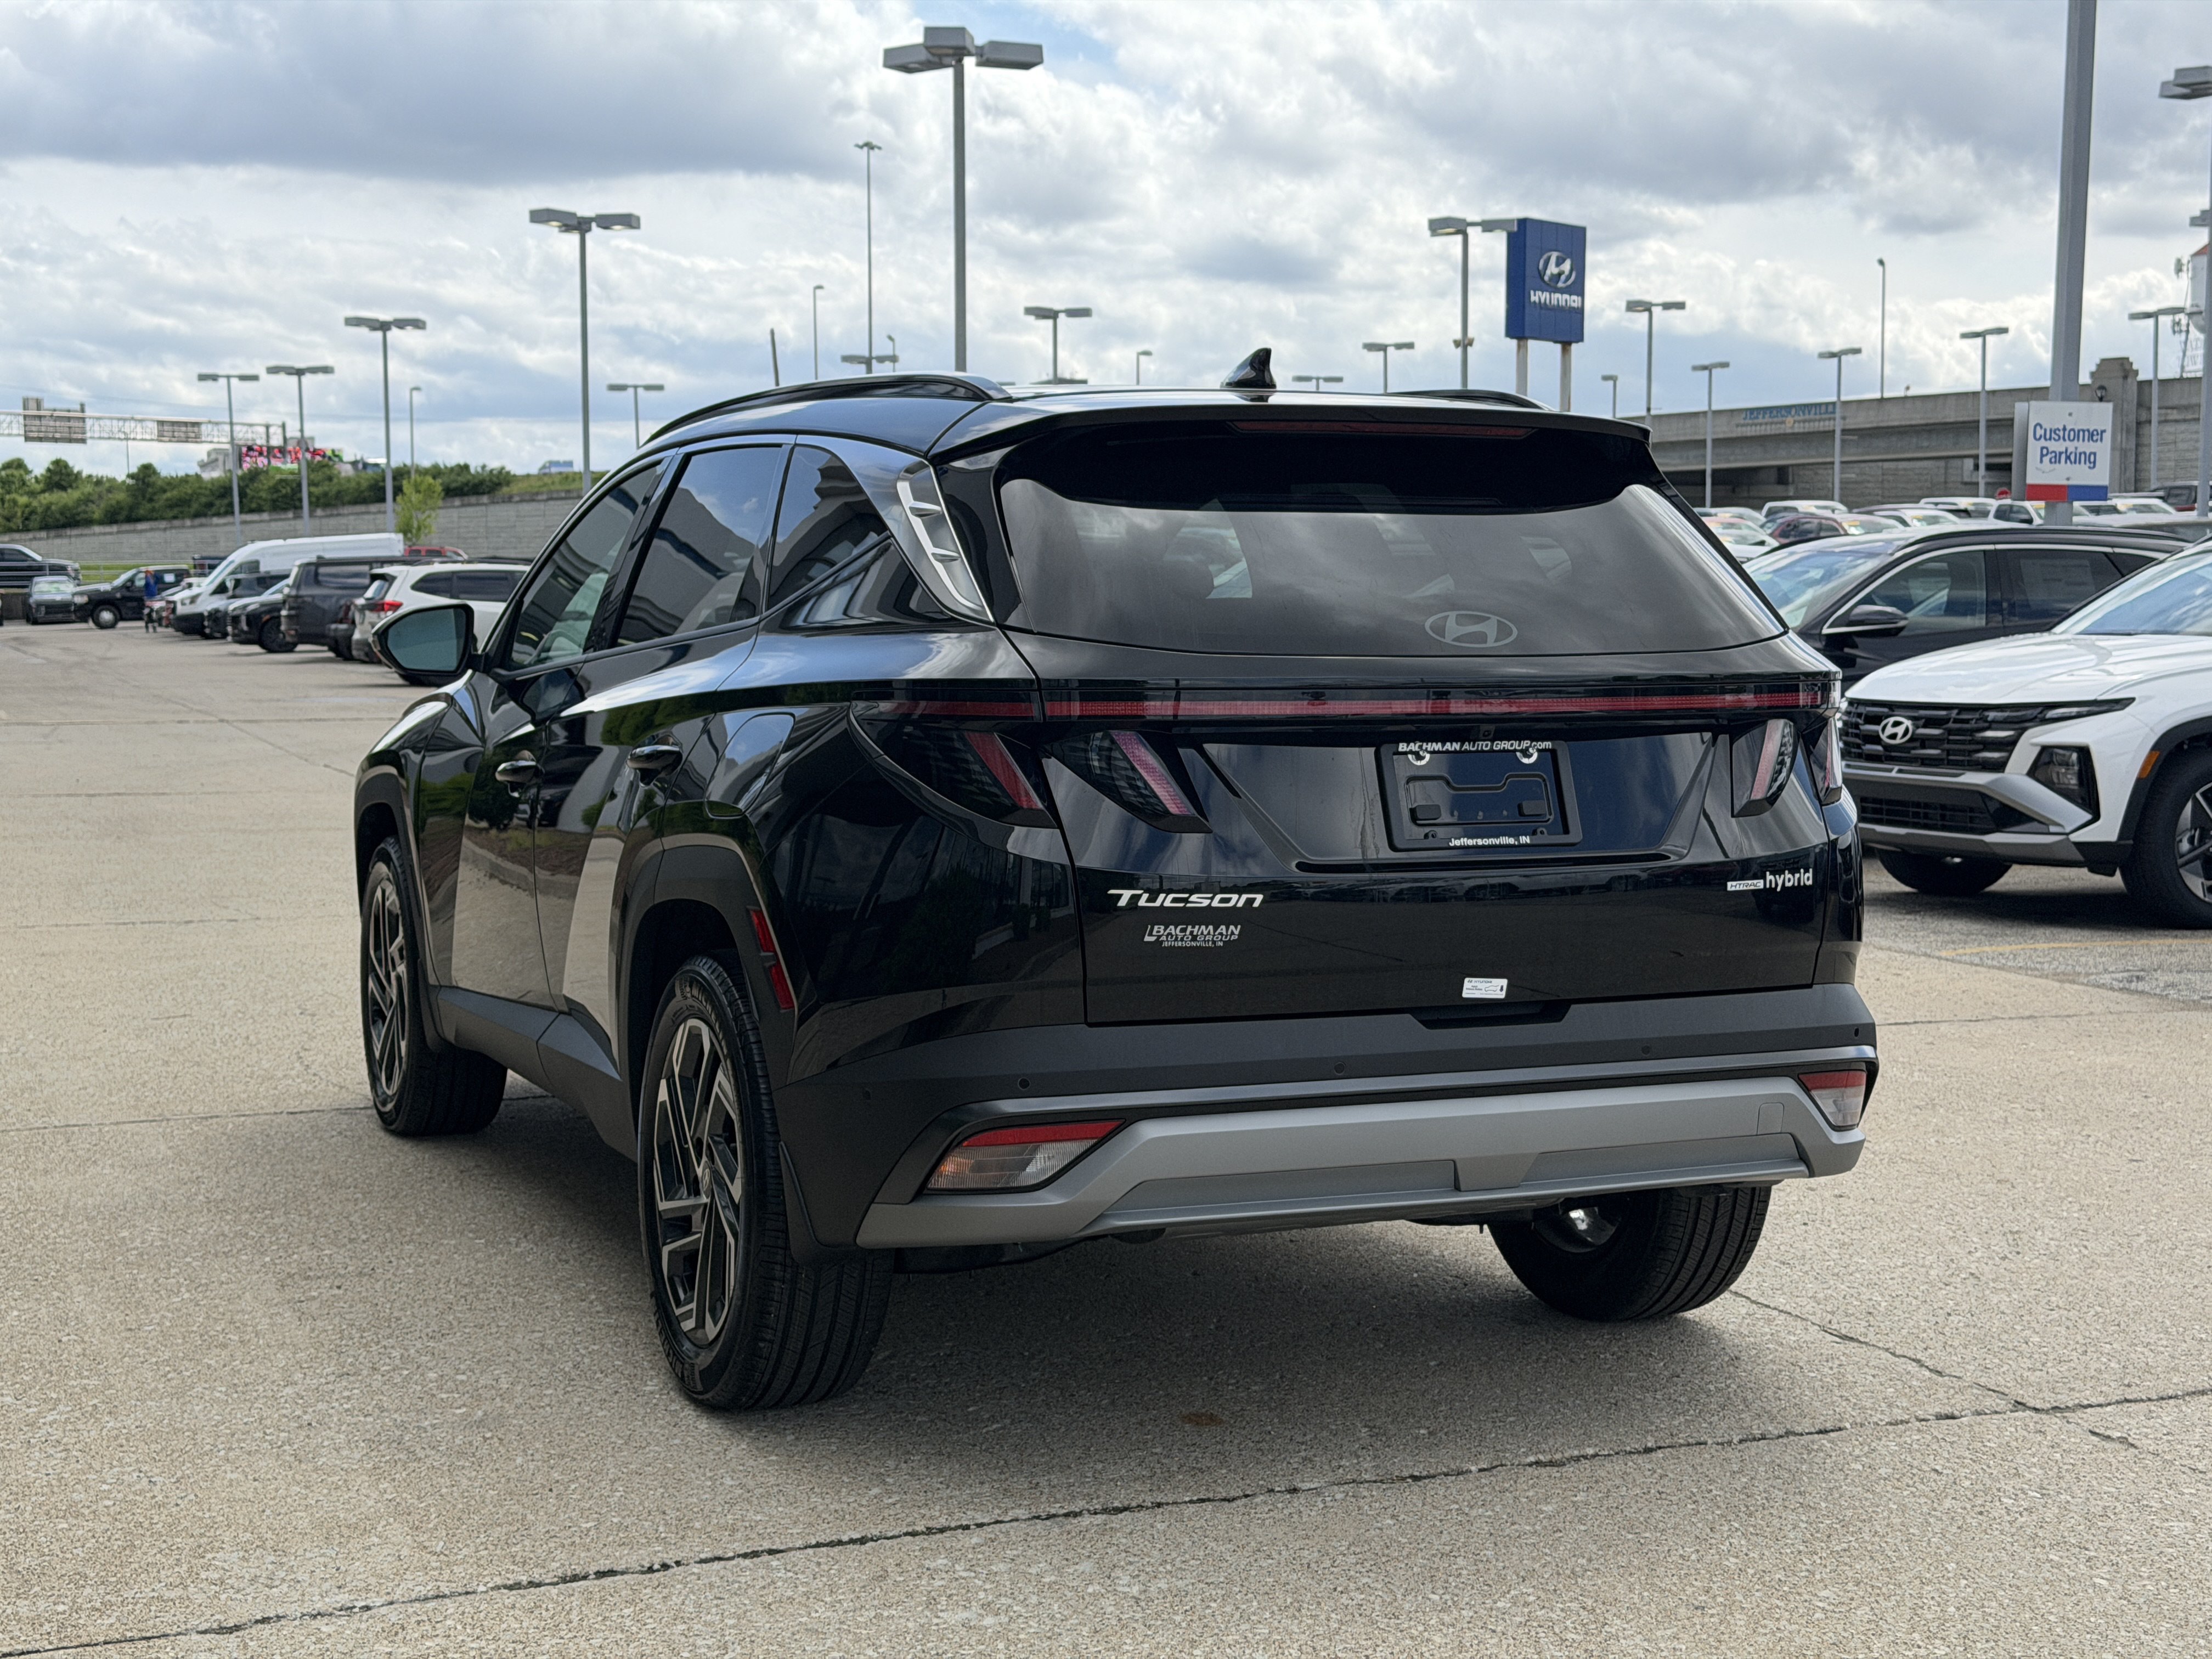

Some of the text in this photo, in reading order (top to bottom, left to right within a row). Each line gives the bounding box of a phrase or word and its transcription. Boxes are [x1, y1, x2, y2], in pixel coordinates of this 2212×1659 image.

[1530, 290, 1582, 308] HYUNDAI
[2033, 422, 2107, 443] Customer
[2039, 445, 2097, 470] Parking
[1398, 742, 1460, 752] BACHMAN
[1461, 741, 1491, 751] AUTO
[1448, 836, 1531, 847] Jeffersonville, IN
[1730, 868, 1813, 892] HTRAC hybrid
[1107, 889, 1264, 907] Tucson
[1152, 924, 1241, 935] BACHMAN
